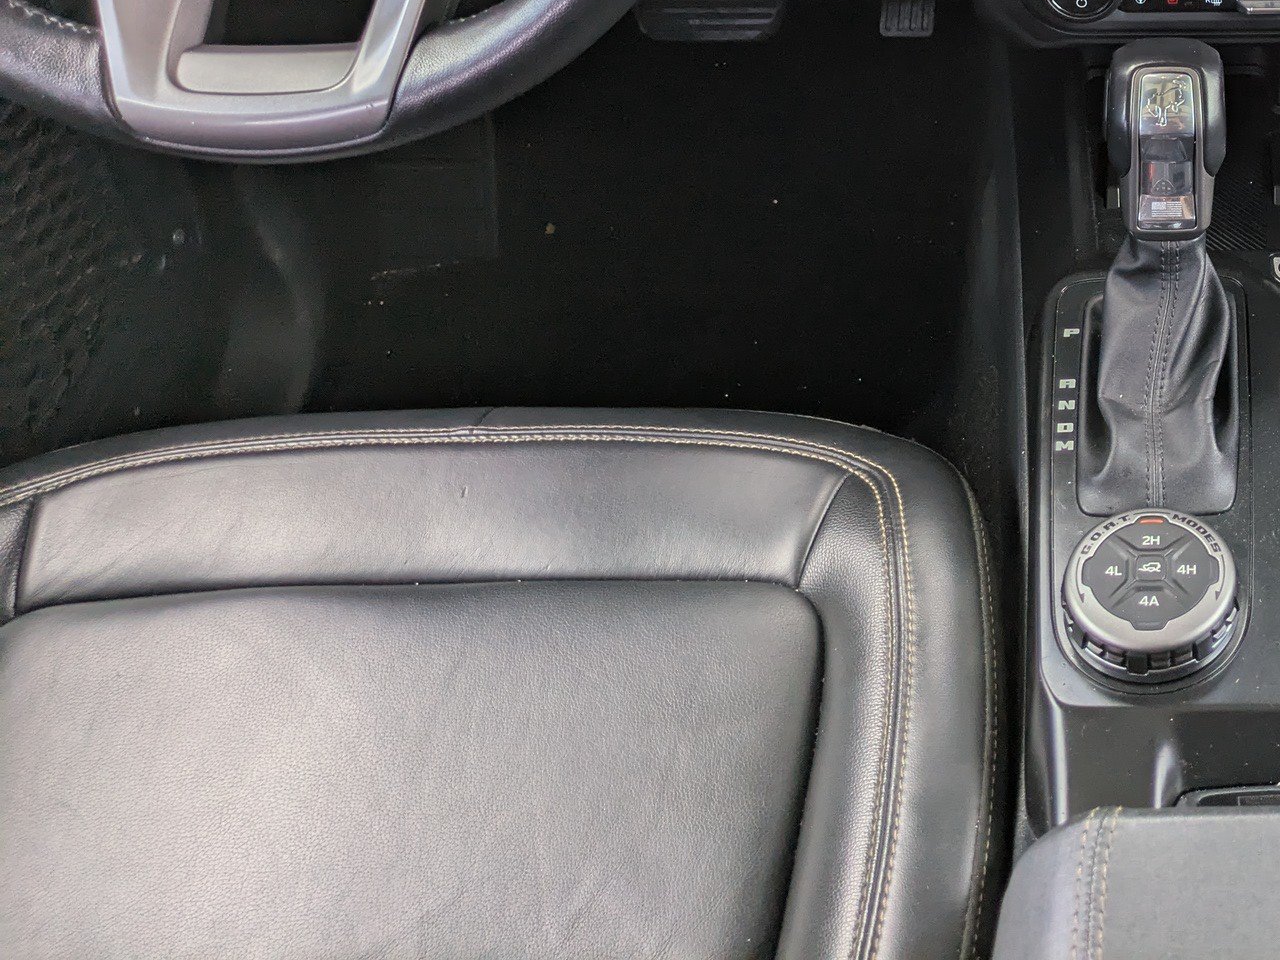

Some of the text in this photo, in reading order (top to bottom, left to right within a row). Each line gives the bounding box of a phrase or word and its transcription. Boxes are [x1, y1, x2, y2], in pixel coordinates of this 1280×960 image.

[1063, 328, 1080, 337] P
[1059, 379, 1076, 388] R
[1058, 400, 1076, 410] N
[1055, 440, 1074, 451] M
[1172, 513, 1222, 553] MODES
[1142, 536, 1160, 545] 2H
[1105, 566, 1122, 575] 4L
[1177, 565, 1197, 574] 4H
[1138, 596, 1160, 606] 4A
